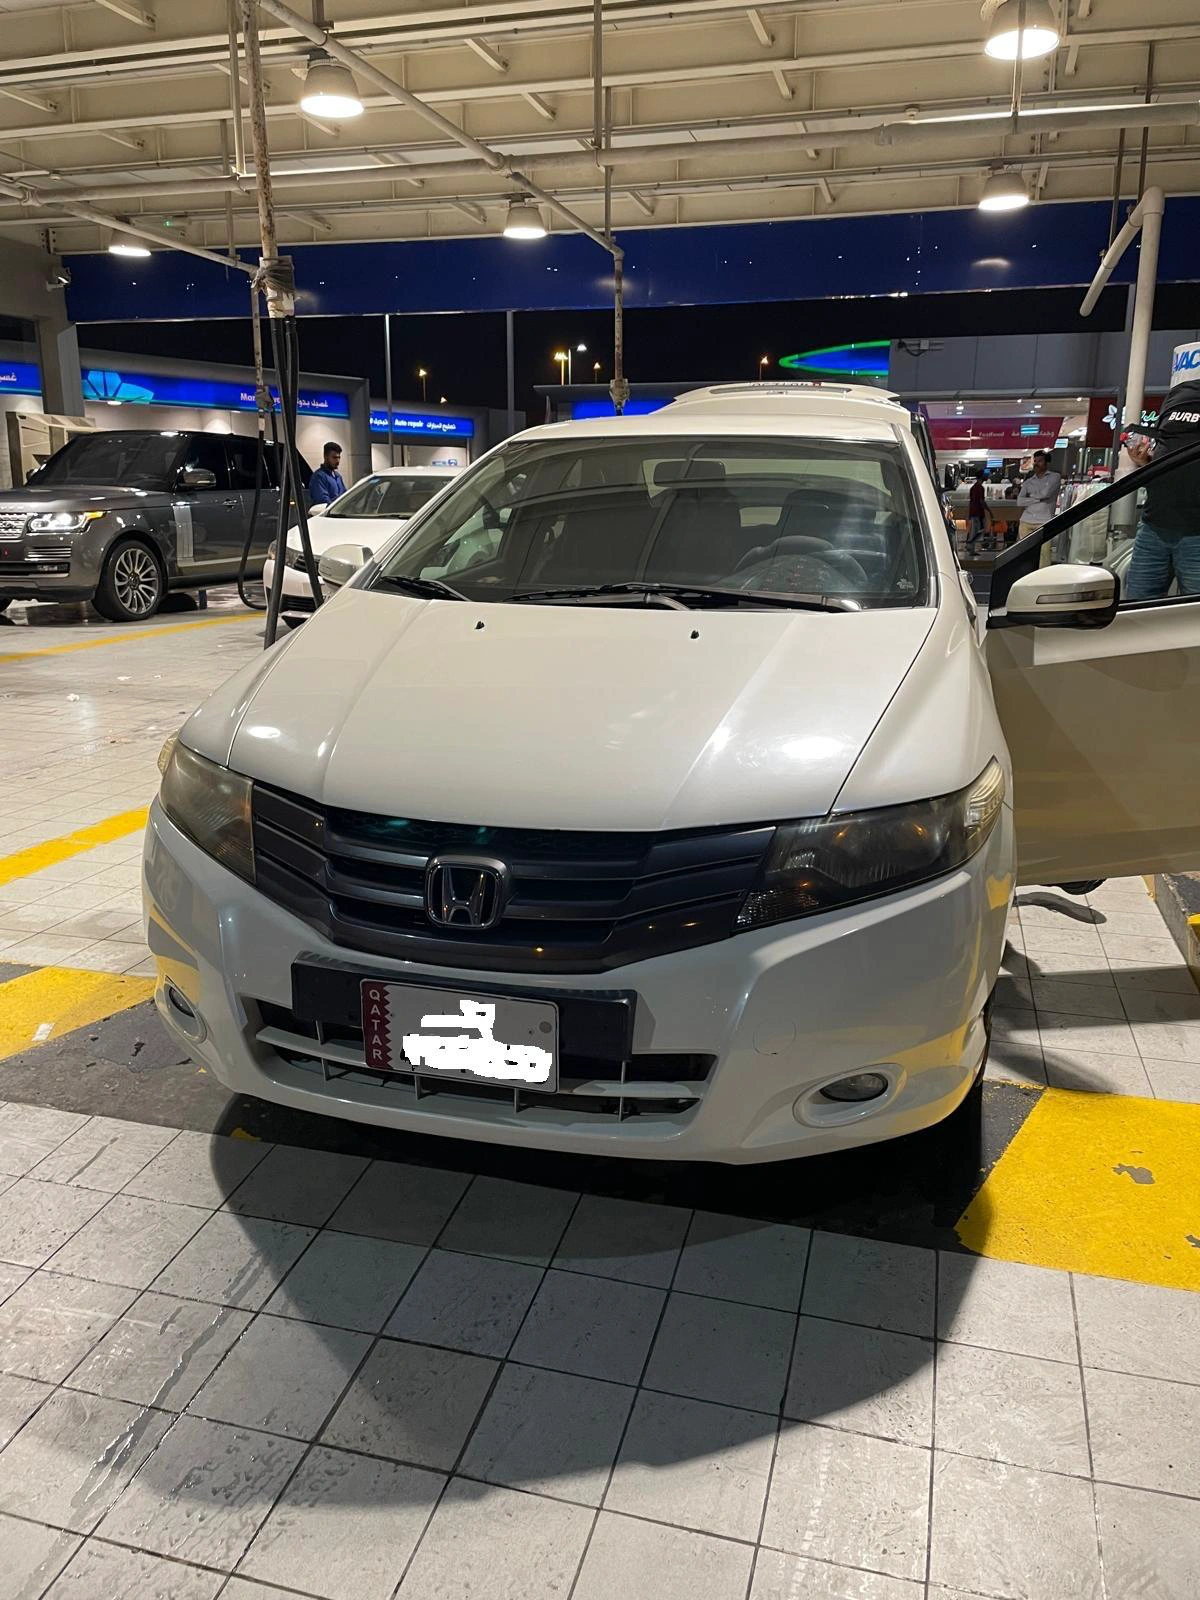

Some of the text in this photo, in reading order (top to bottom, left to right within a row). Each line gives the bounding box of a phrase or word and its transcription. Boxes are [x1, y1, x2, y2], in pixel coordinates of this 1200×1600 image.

[1168, 411, 1200, 423] BURB
[394, 418, 424, 429] Auto repair
[369, 989, 383, 1061] QATAR
